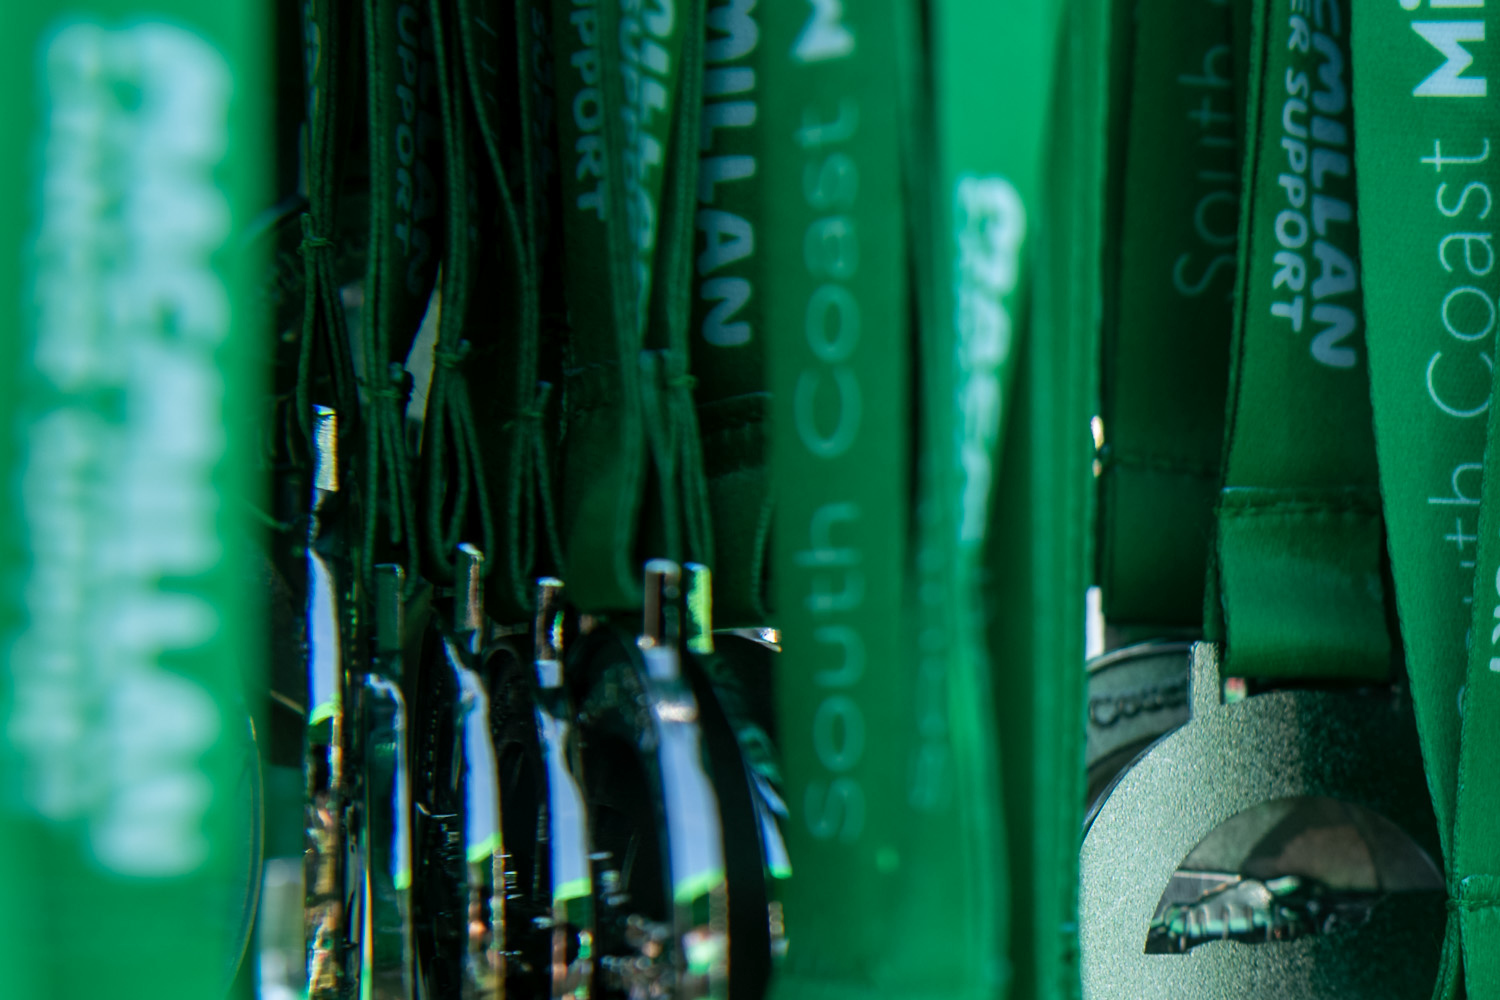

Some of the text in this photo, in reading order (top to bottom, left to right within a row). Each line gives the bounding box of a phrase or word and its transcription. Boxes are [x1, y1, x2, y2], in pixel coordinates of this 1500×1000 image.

[570, 0, 609, 222] PPORT
[1269, 65, 1309, 333] SUPPORT
[1420, 138, 1494, 417] Coast
